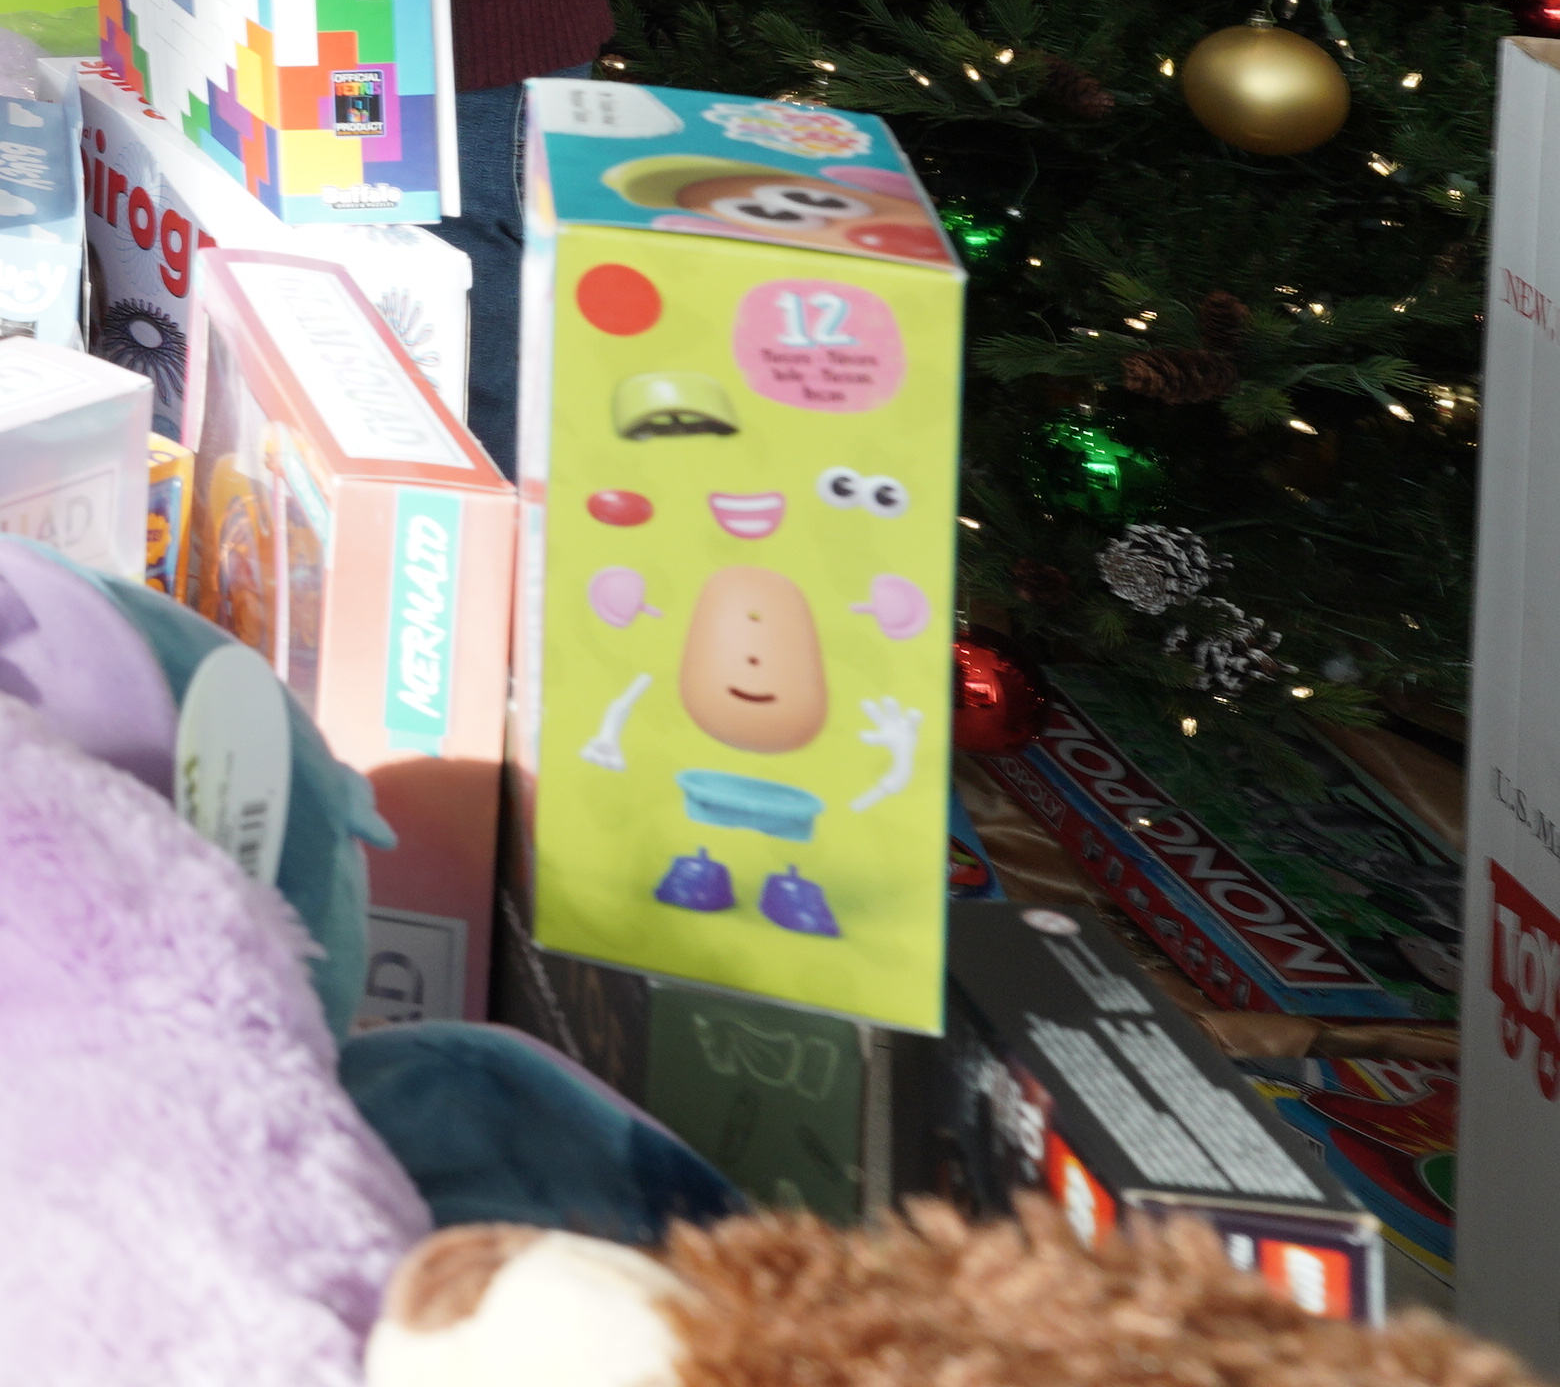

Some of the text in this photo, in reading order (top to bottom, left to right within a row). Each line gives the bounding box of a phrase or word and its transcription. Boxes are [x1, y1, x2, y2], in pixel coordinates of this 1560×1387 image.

[334, 73, 382, 83] OFFICIAL
[335, 82, 382, 96] TETRIS
[336, 121, 384, 132] PRODUCT
[323, 183, 402, 205] Buffalo
[776, 290, 857, 347] 12
[397, 515, 451, 718] MERMAID
